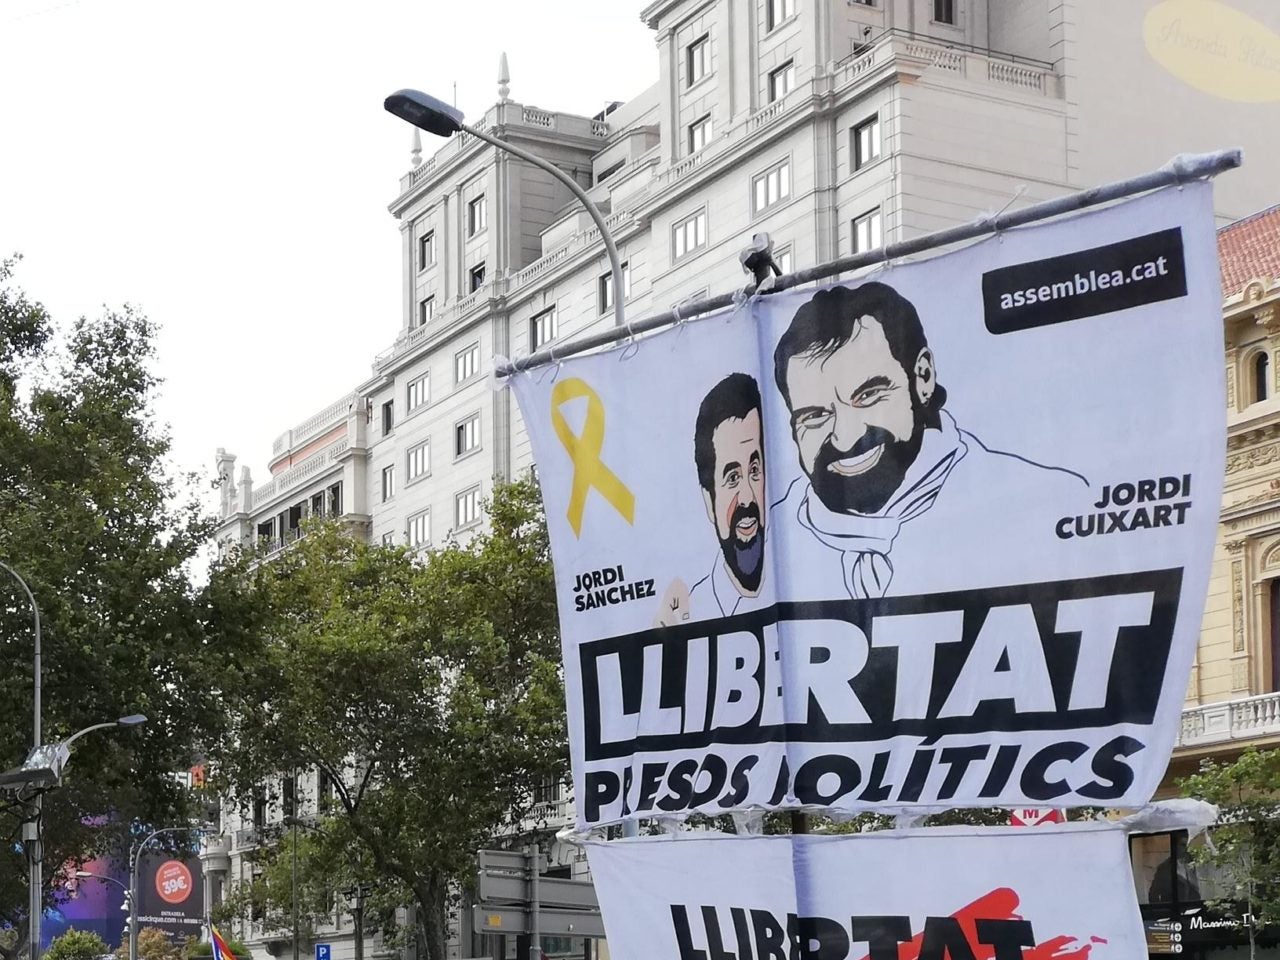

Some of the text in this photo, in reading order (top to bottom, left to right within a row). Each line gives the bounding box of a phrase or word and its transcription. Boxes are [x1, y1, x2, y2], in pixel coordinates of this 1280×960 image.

[1000, 256, 1169, 310] assemblea.cat
[1094, 473, 1192, 509] JORDI
[1055, 501, 1193, 540] CUIXART
[572, 564, 625, 593] JORDI
[595, 590, 1156, 745] LLIBERTAT
[161, 875, 188, 896] 39€
[1190, 915, 1239, 930] Massimo
[319, 947, 327, 957] P
